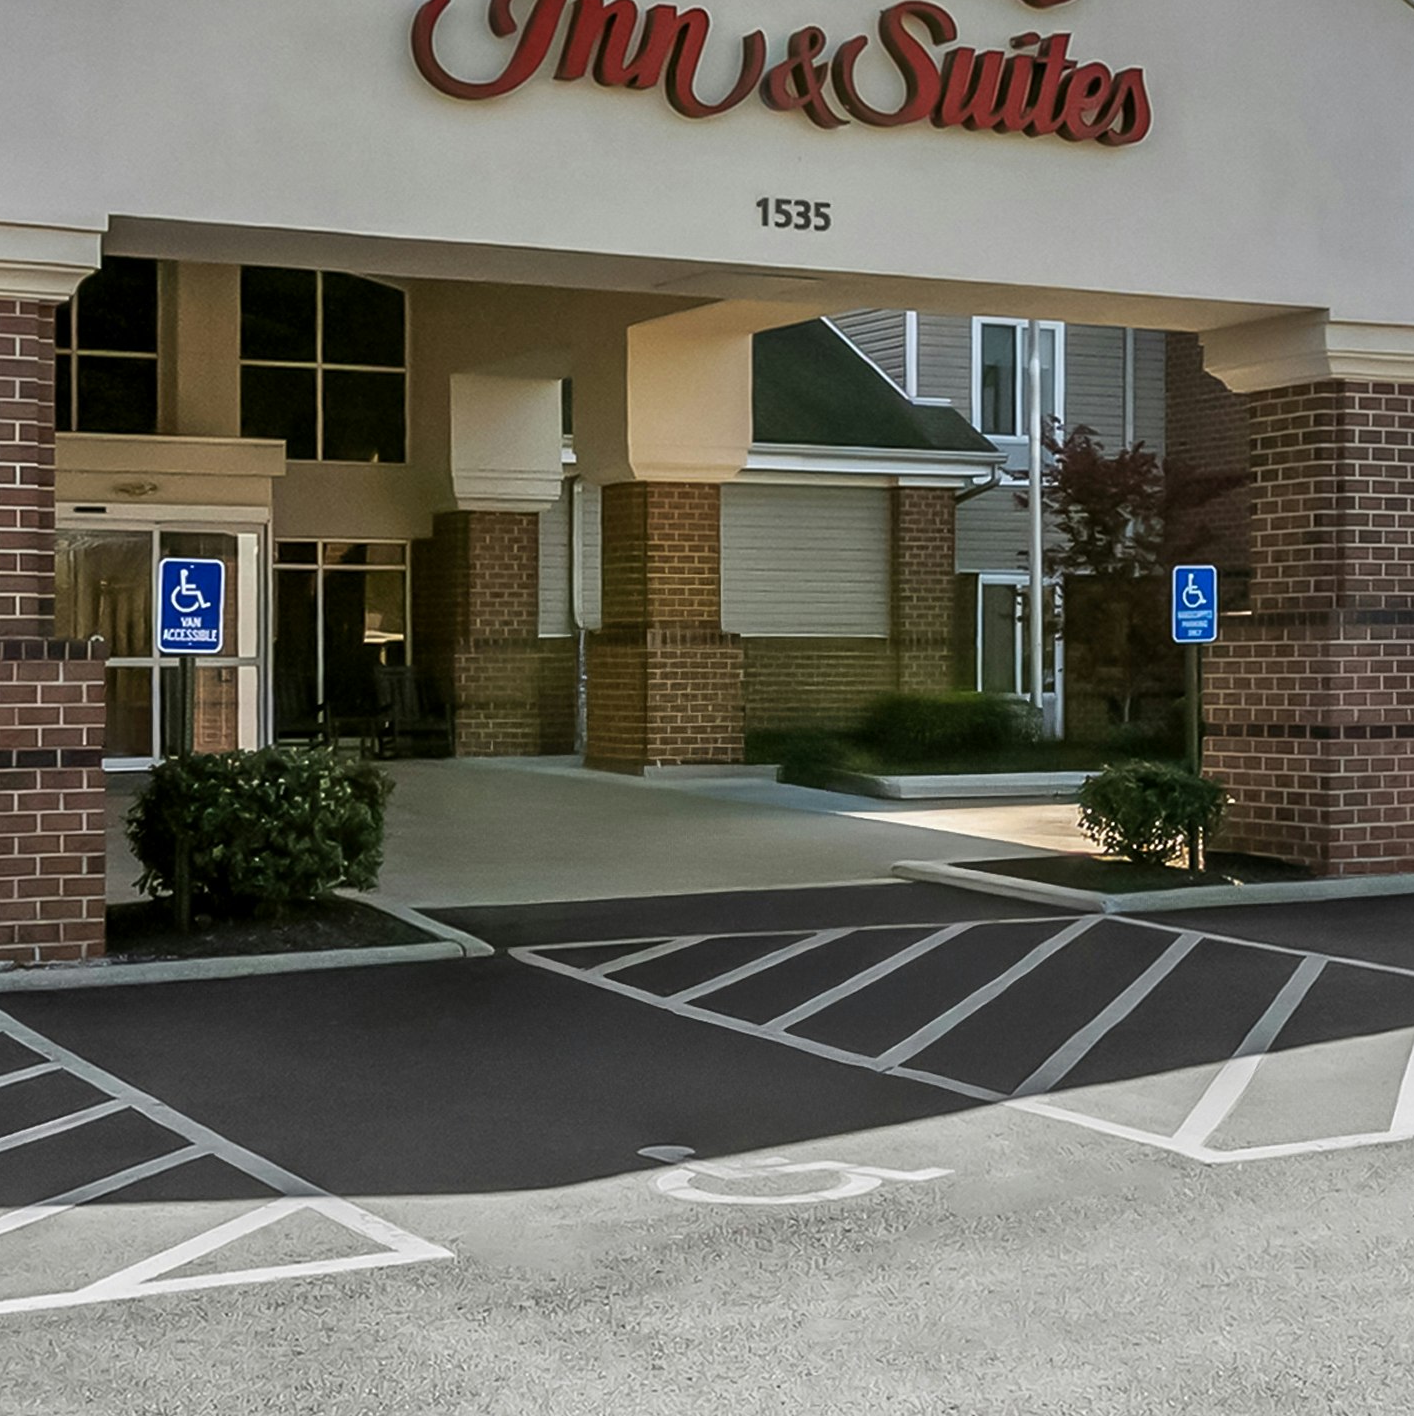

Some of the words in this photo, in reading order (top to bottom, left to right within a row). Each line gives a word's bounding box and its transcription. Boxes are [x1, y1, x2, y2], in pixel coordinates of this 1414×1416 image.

[761, 25, 852, 130] &
[831, 0, 1153, 147] Suites
[755, 197, 832, 232] 1535
[180, 617, 202, 628] VAN
[163, 629, 217, 642] ACCESSIBLE
